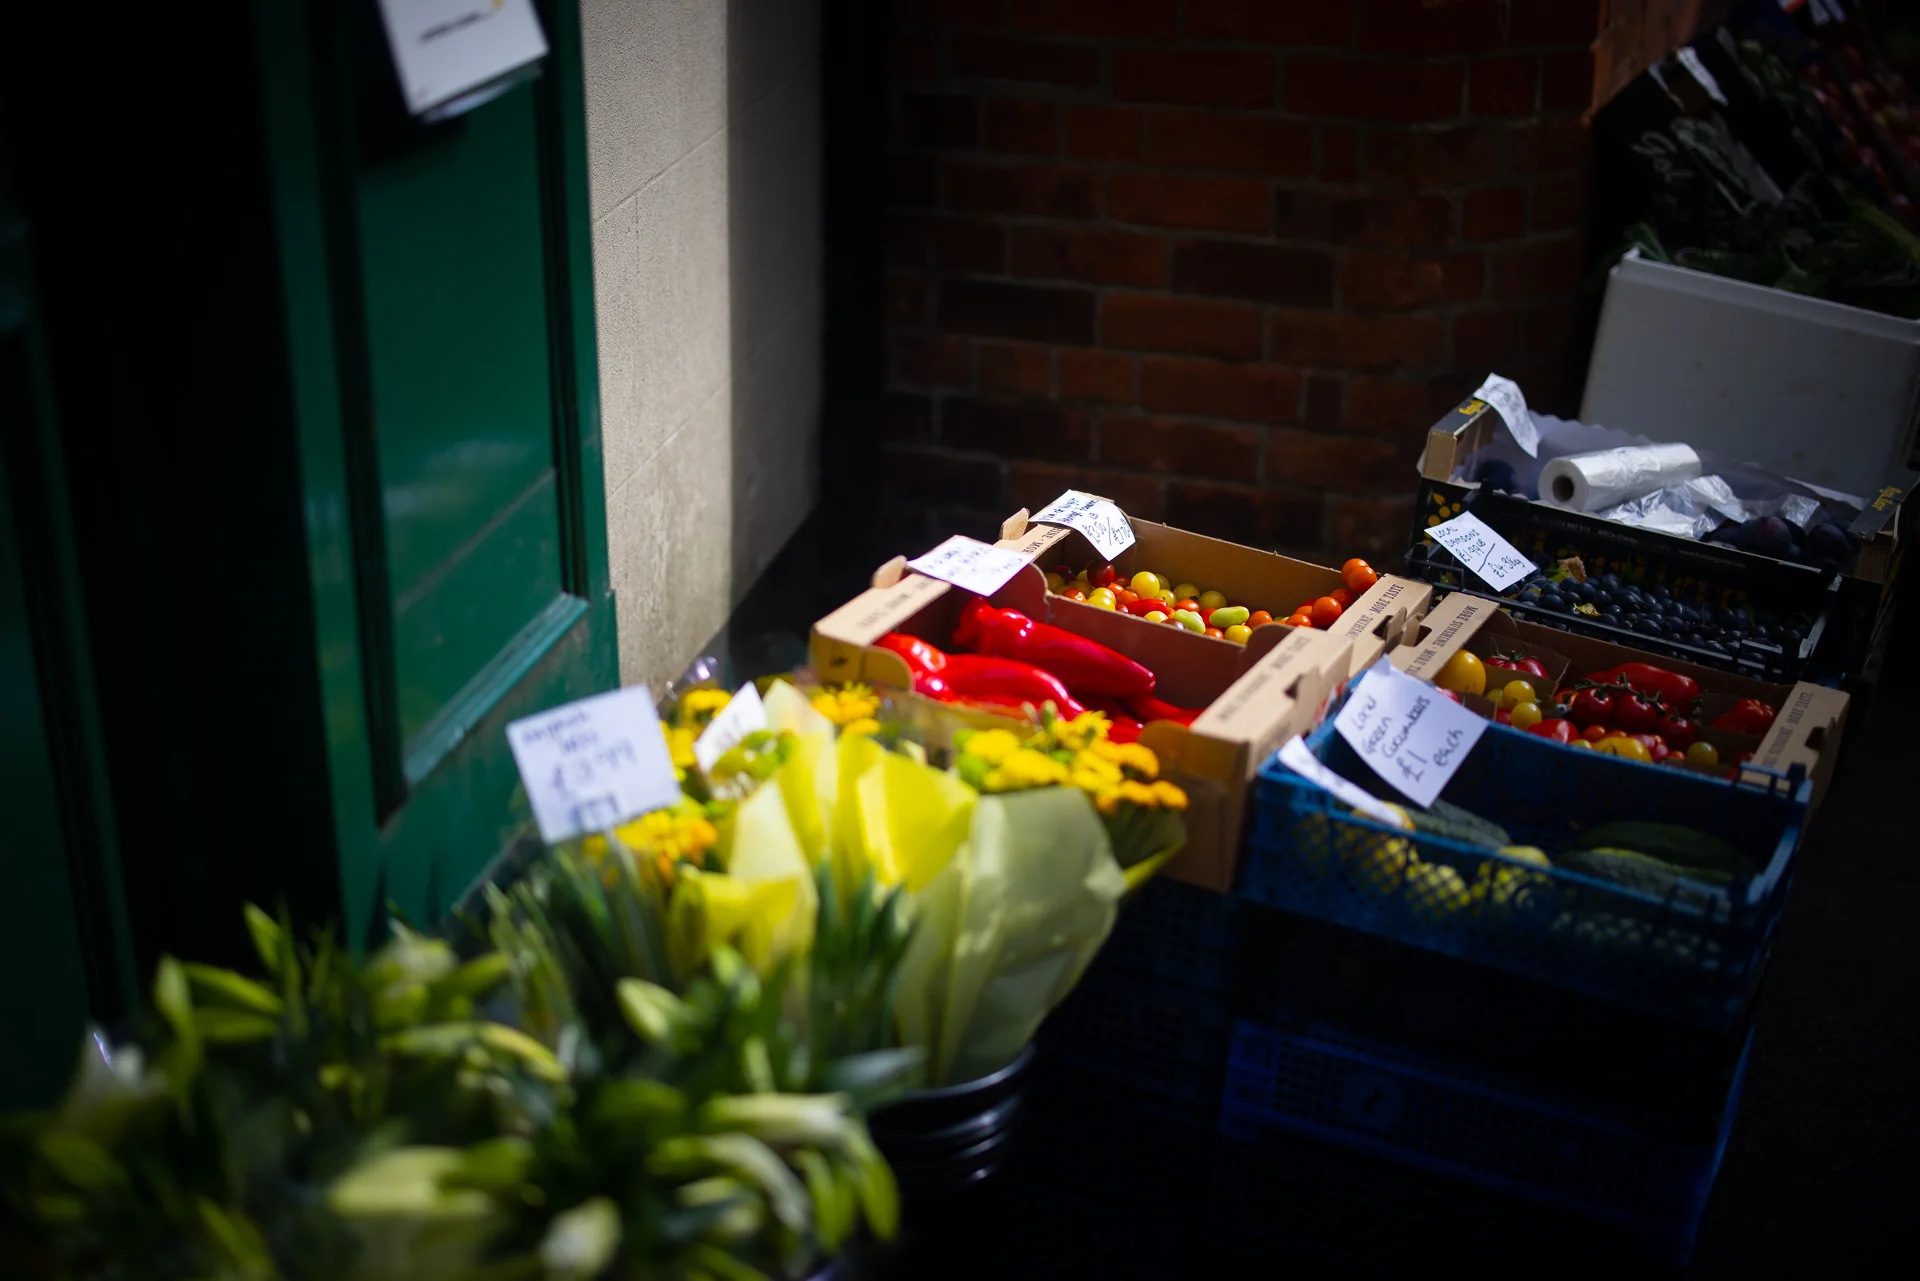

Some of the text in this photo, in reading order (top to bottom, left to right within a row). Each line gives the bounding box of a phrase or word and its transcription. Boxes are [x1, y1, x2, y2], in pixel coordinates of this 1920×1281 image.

[1433, 525, 1458, 539] LOCAL
[1444, 529, 1480, 548] DAMSONS
[1369, 597, 1391, 614] MORE
[1386, 583, 1404, 600] TASTE
[1457, 605, 1479, 623] MORE
[1432, 615, 1463, 648] SUNSHINE
[1414, 648, 1437, 667] MORE
[1432, 727, 1464, 767] each
